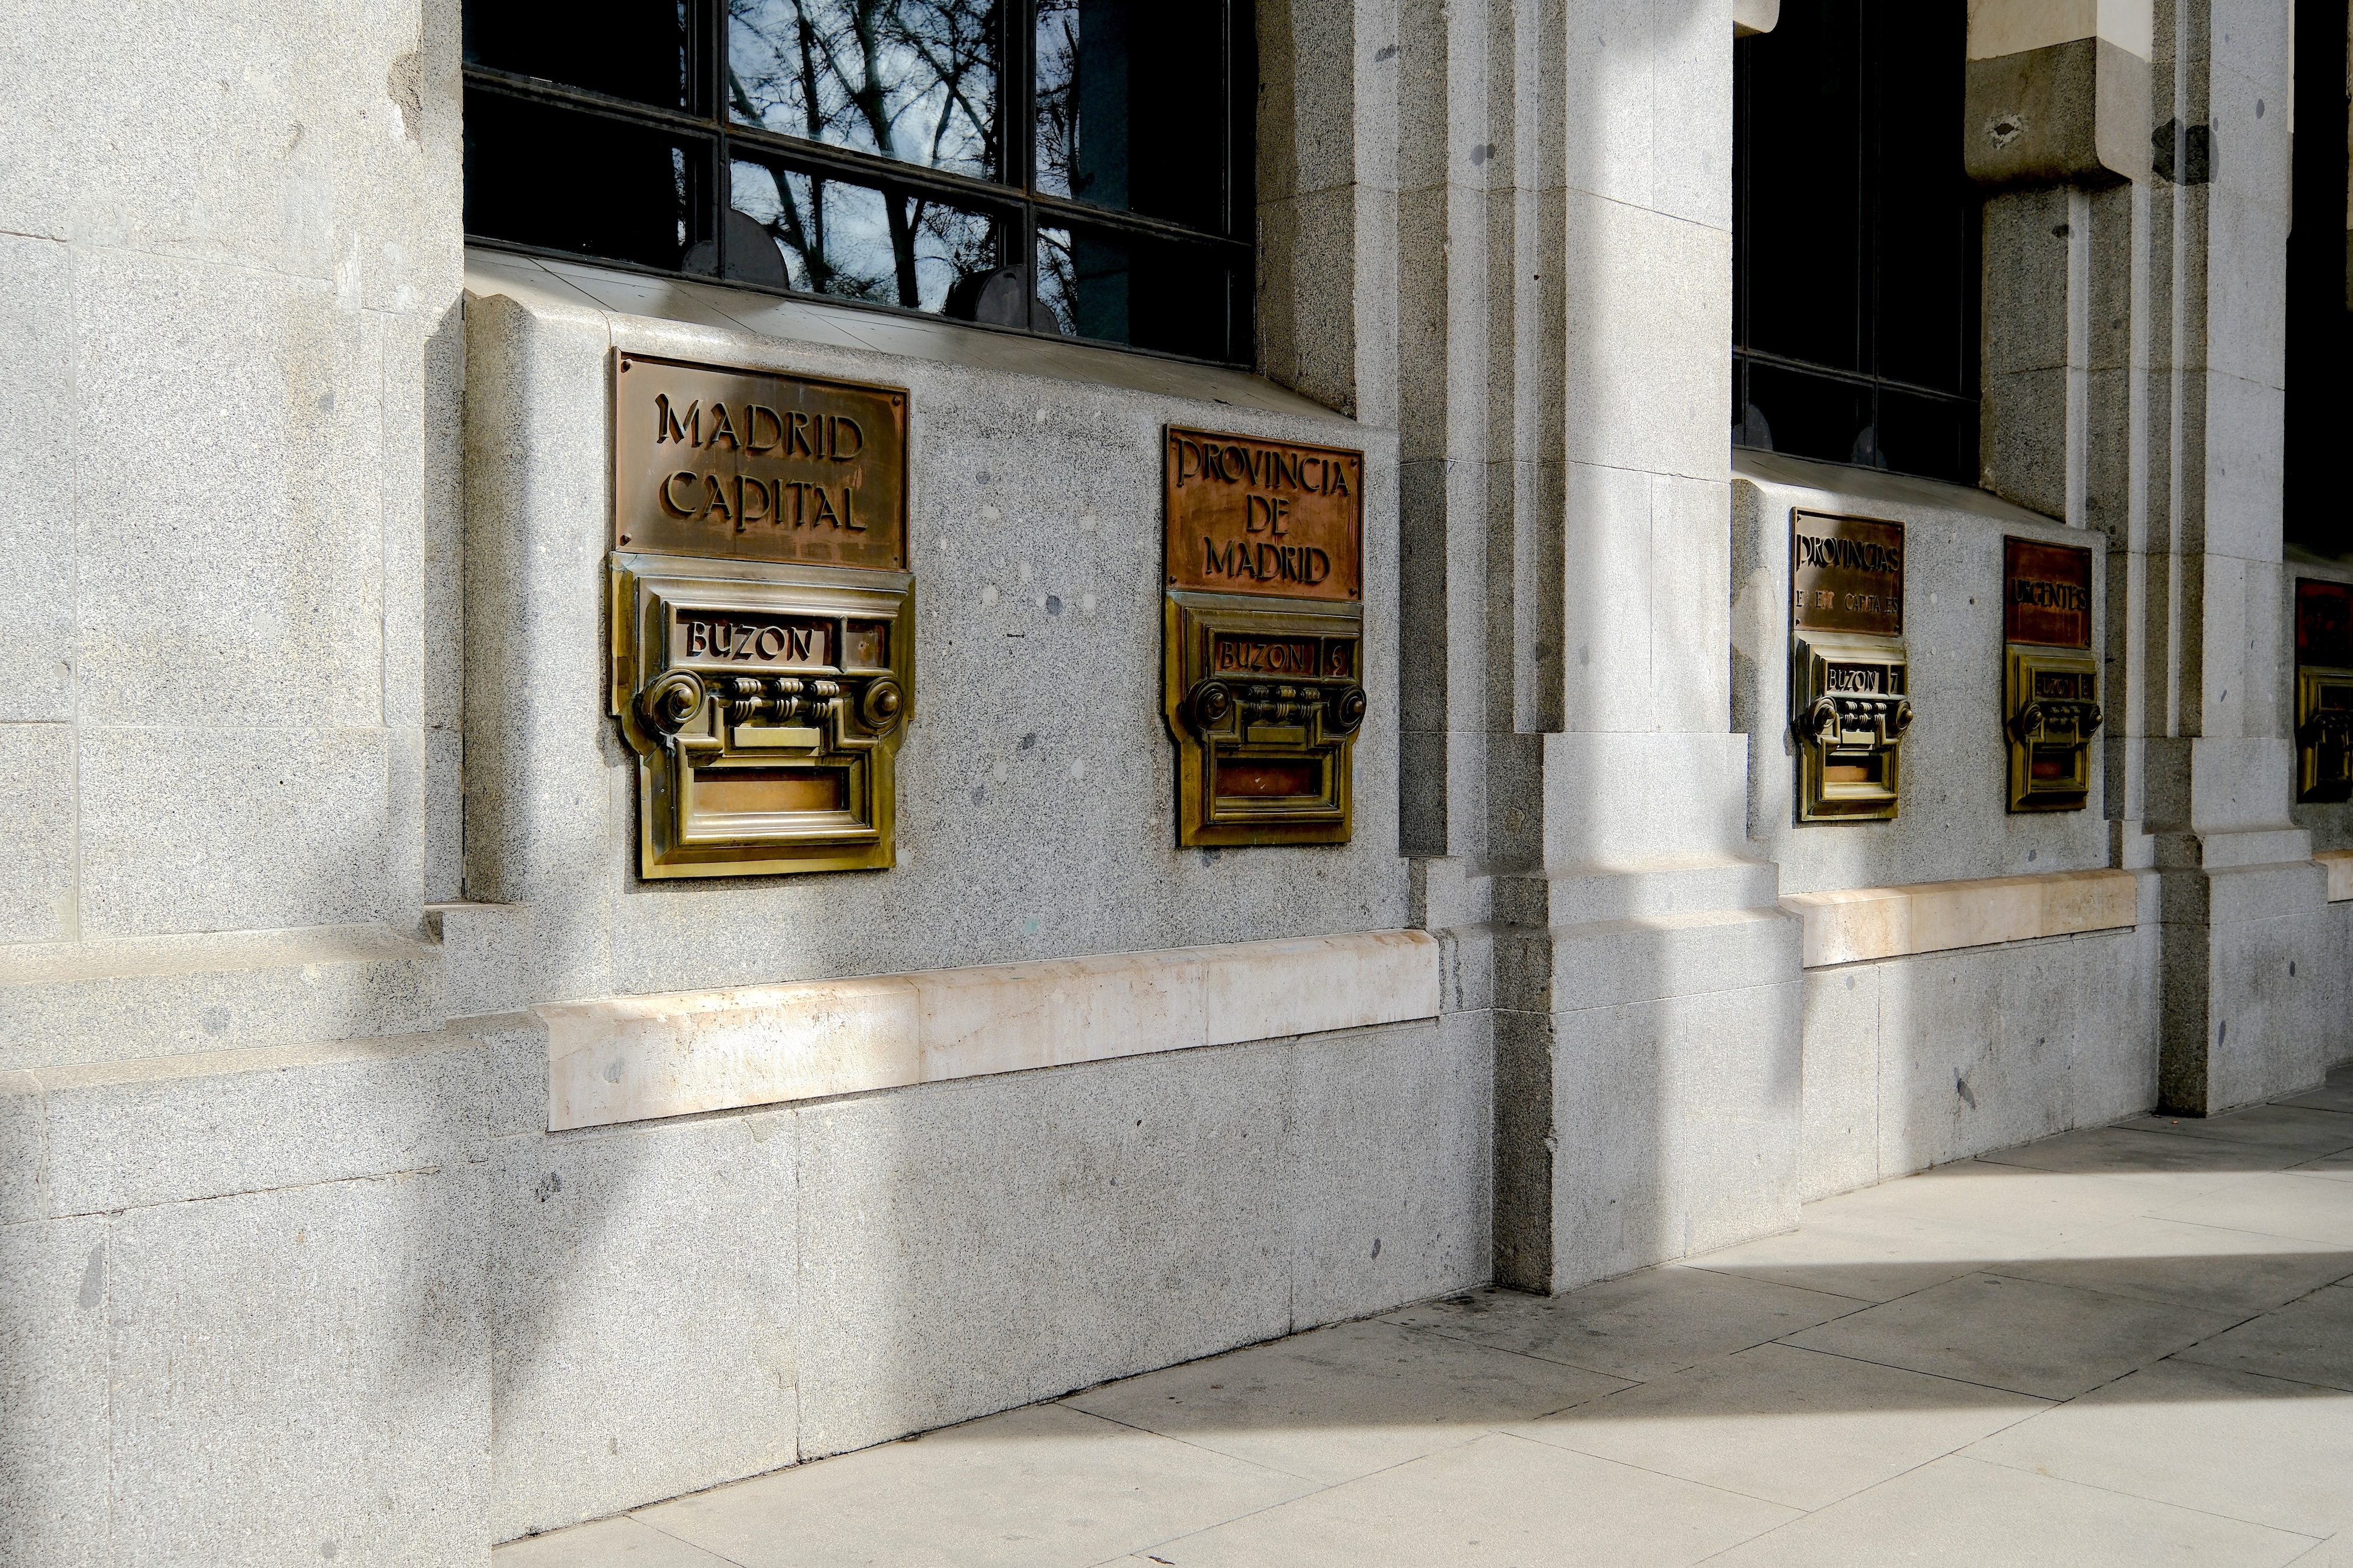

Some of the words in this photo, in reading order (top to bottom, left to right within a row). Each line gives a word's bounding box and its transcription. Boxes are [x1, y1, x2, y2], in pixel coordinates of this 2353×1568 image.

[655, 393, 865, 462] MADRID
[1177, 438, 1351, 495] PROVINCIA
[661, 471, 868, 532] CAPITAL
[1247, 495, 1290, 535] DE
[1204, 536, 1331, 584] MADRID
[1797, 533, 1900, 572] PROVINCIAS
[2011, 578, 2087, 610] URGENTES
[687, 621, 815, 660] BUZON
[1221, 641, 1304, 670] BUZON
[1331, 645, 1342, 669] 6
[1829, 669, 1877, 692] BUZON
[1891, 672, 1899, 690] 7
